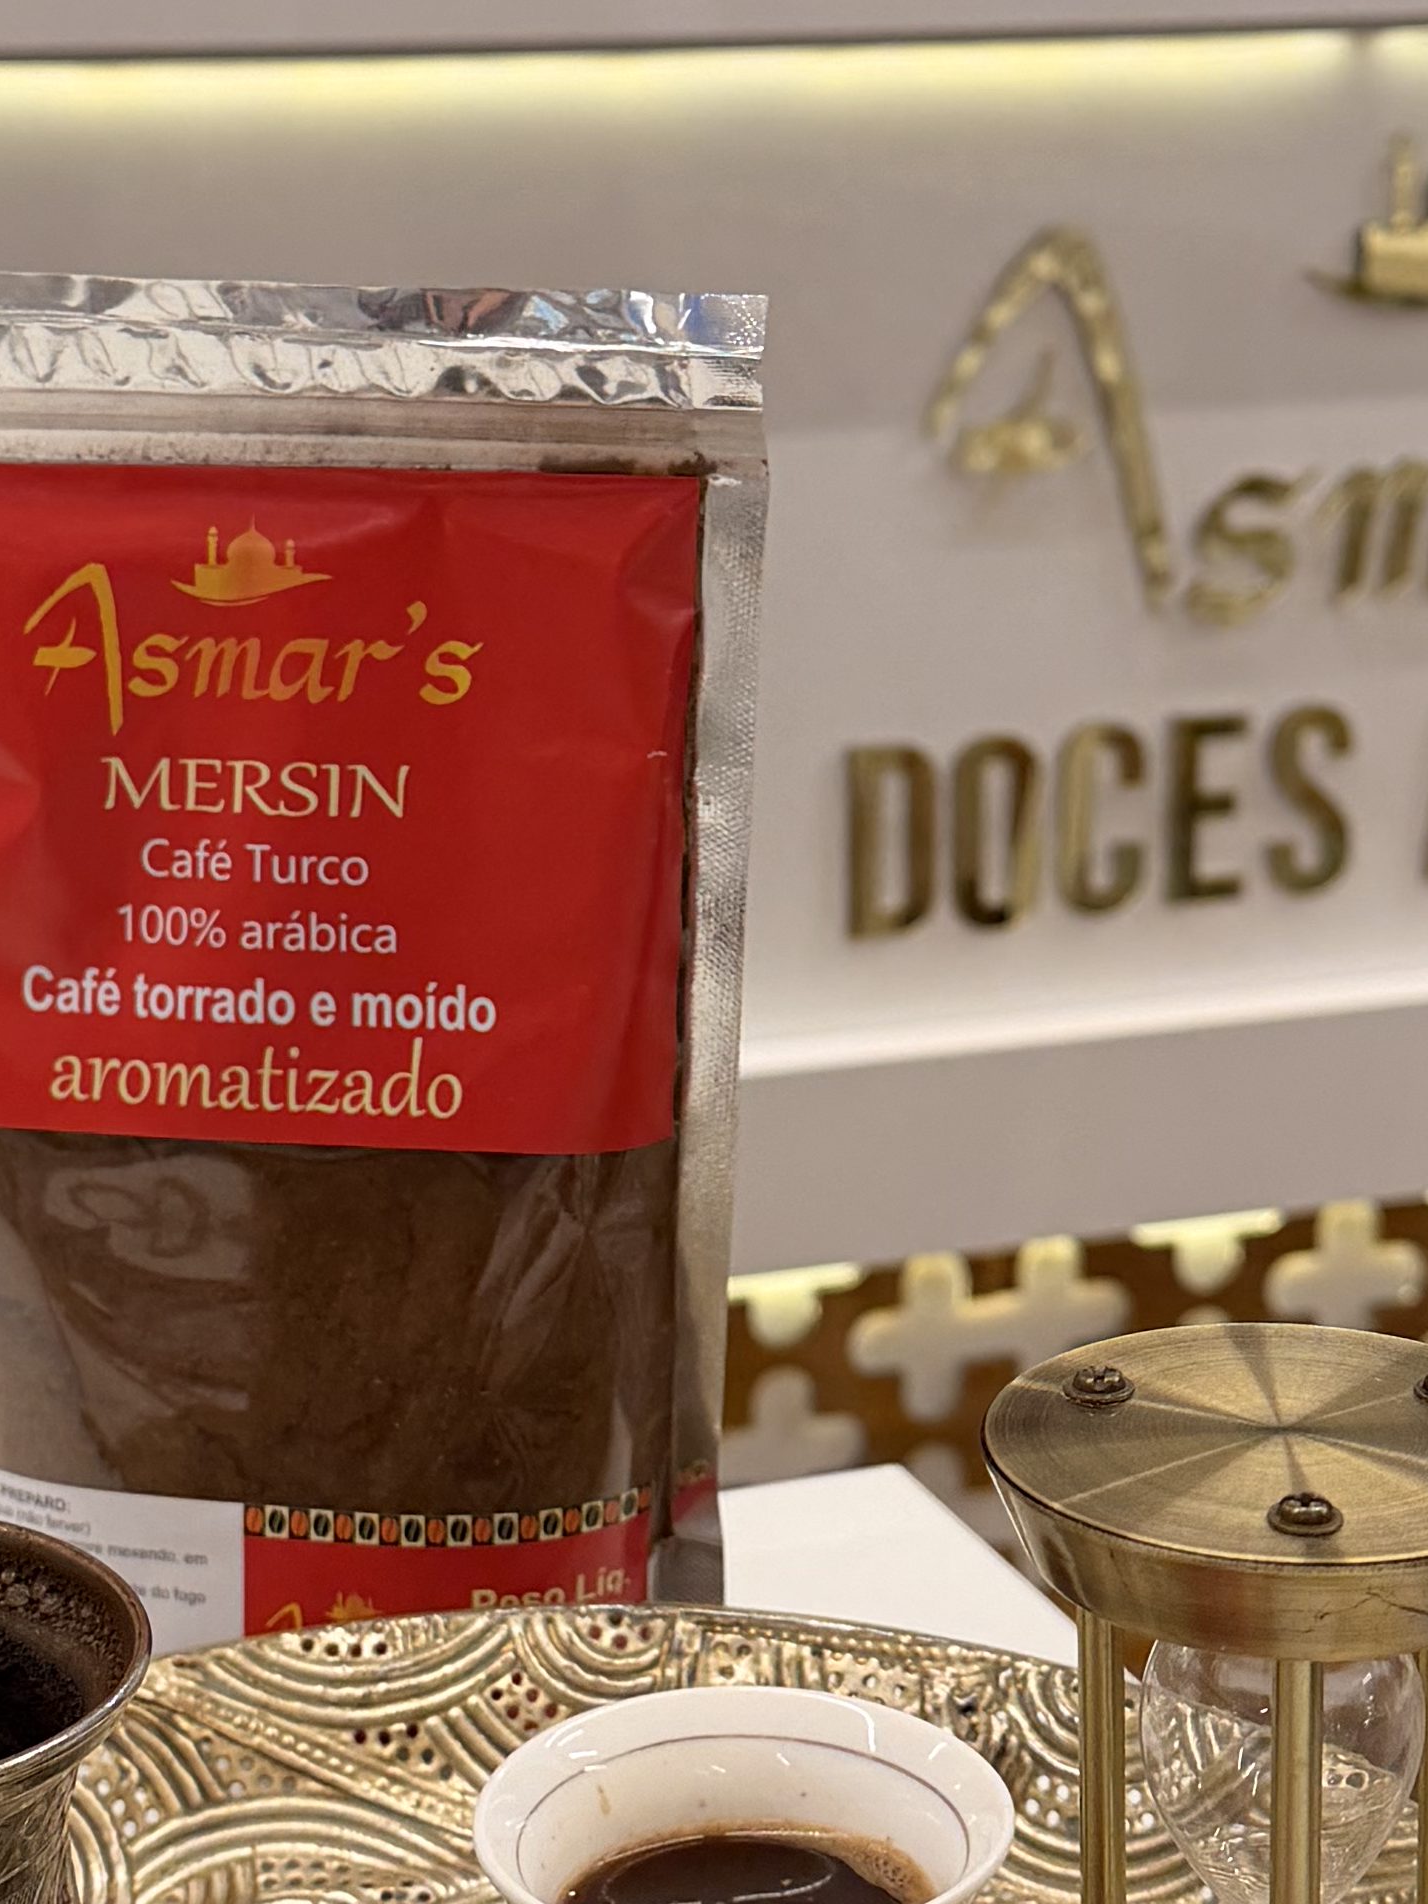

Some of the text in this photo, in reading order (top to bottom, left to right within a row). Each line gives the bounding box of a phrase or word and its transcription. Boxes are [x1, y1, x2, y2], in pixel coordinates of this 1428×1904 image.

[23, 562, 484, 736] Asmar's
[100, 755, 411, 819] MERSIN
[842, 702, 1357, 942] DOCES
[140, 836, 370, 887] Café Turco
[117, 904, 398, 956] 100% arábica
[21, 964, 498, 1034] Café torrado e moído
[49, 1037, 464, 1121] aromatizado
